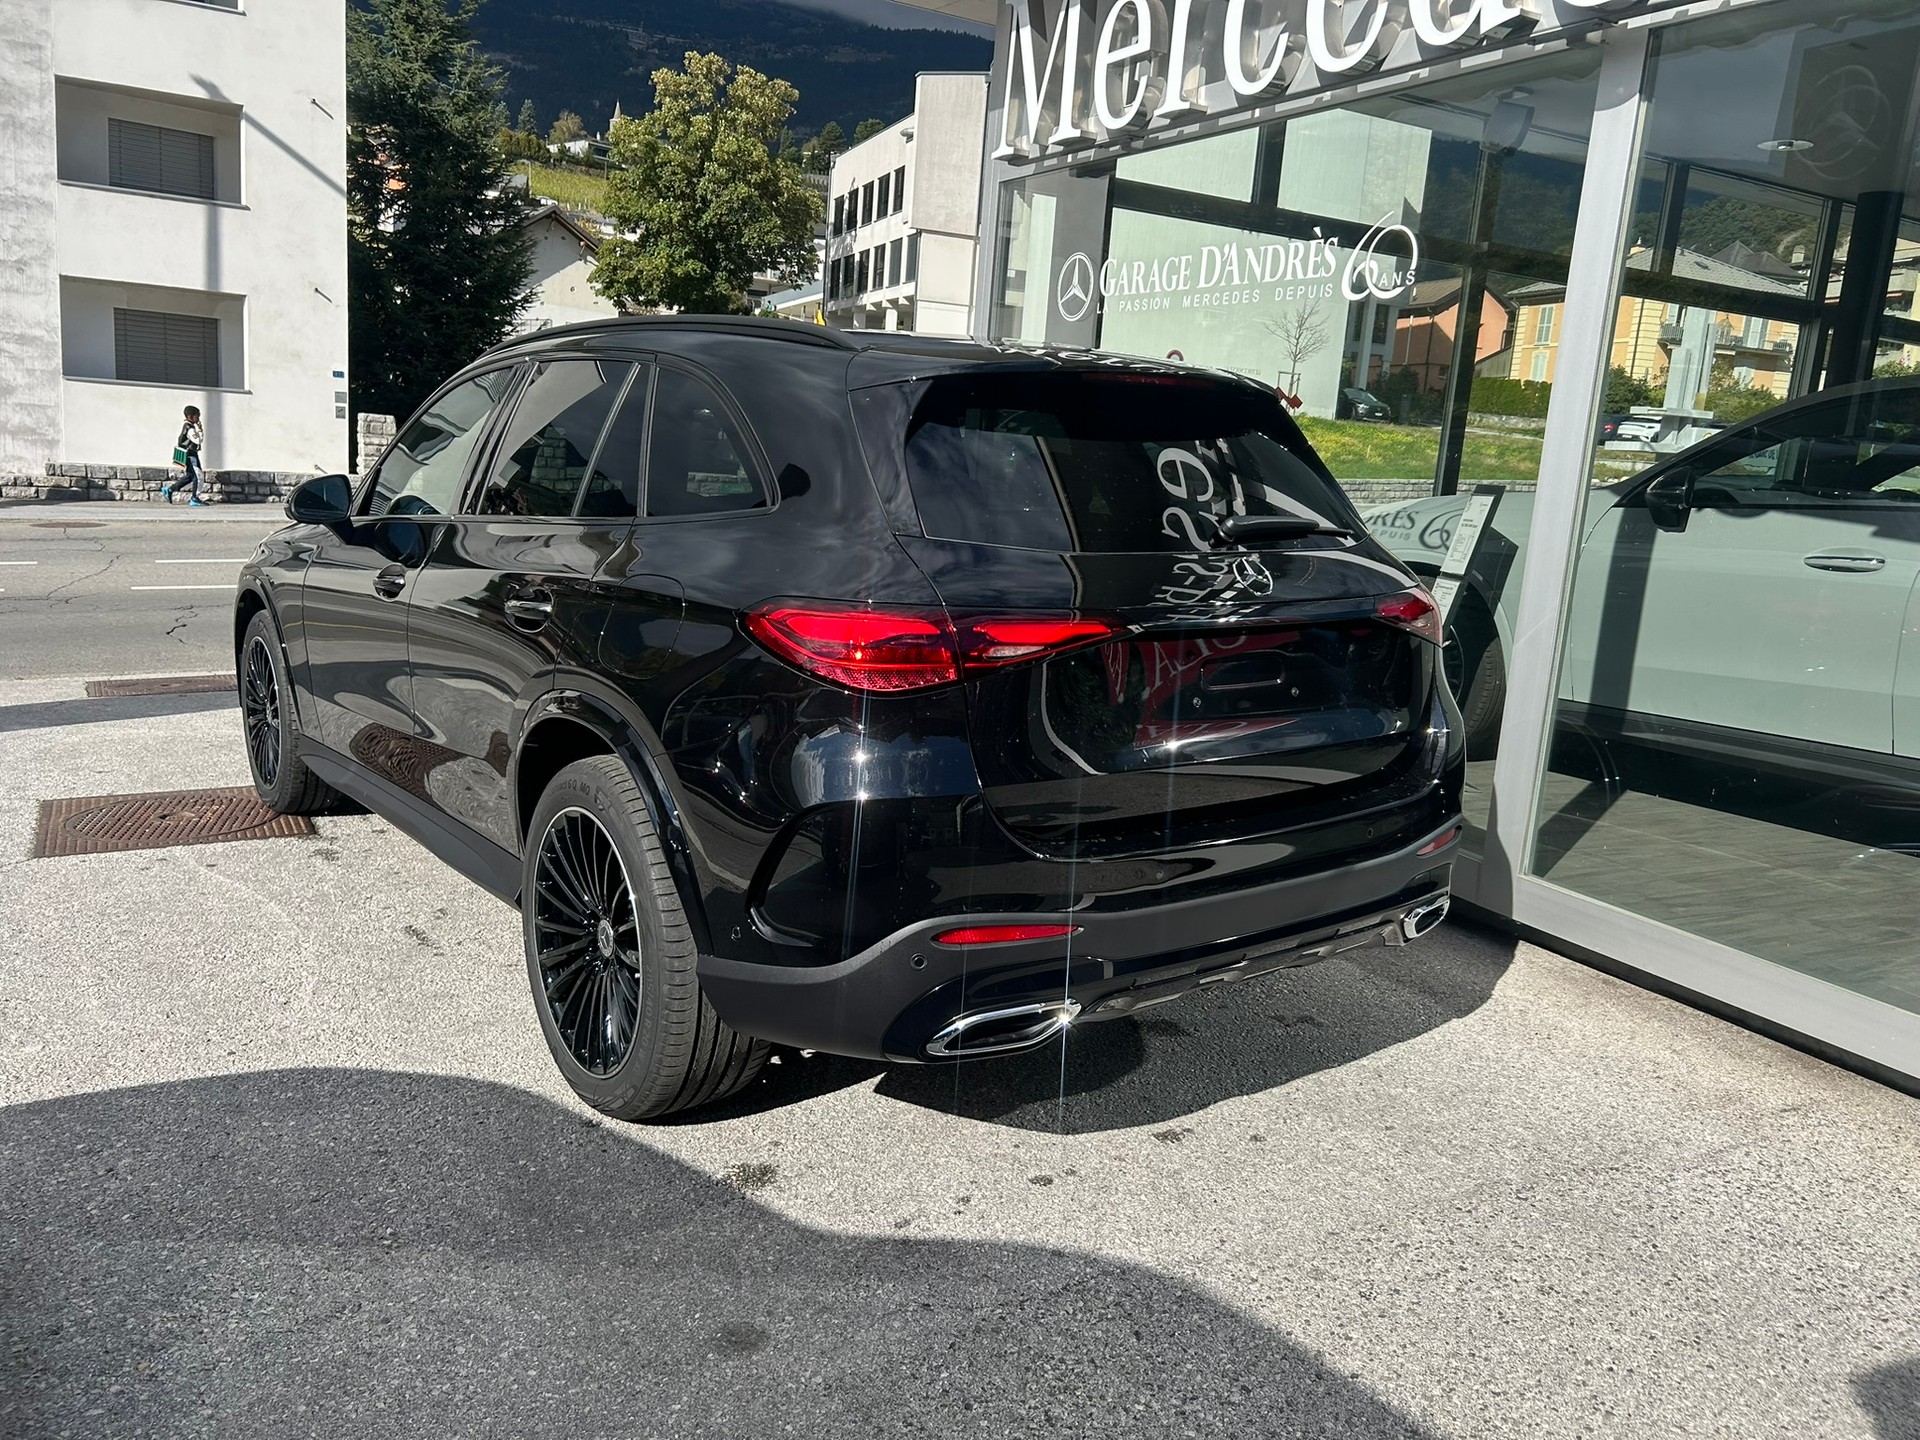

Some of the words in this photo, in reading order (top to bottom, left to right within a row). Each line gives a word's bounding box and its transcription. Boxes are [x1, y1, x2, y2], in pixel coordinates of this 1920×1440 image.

[1100, 255, 1192, 297] GARAGE
[1197, 226, 1339, 289] D'ANDRÈS
[1341, 210, 1418, 301] 60
[1378, 270, 1416, 288] ANS
[1097, 303, 1109, 314] LA
[1119, 297, 1170, 313] PASSION
[1182, 289, 1260, 308] MERCEDES
[1275, 283, 1333, 301] DEPUIS
